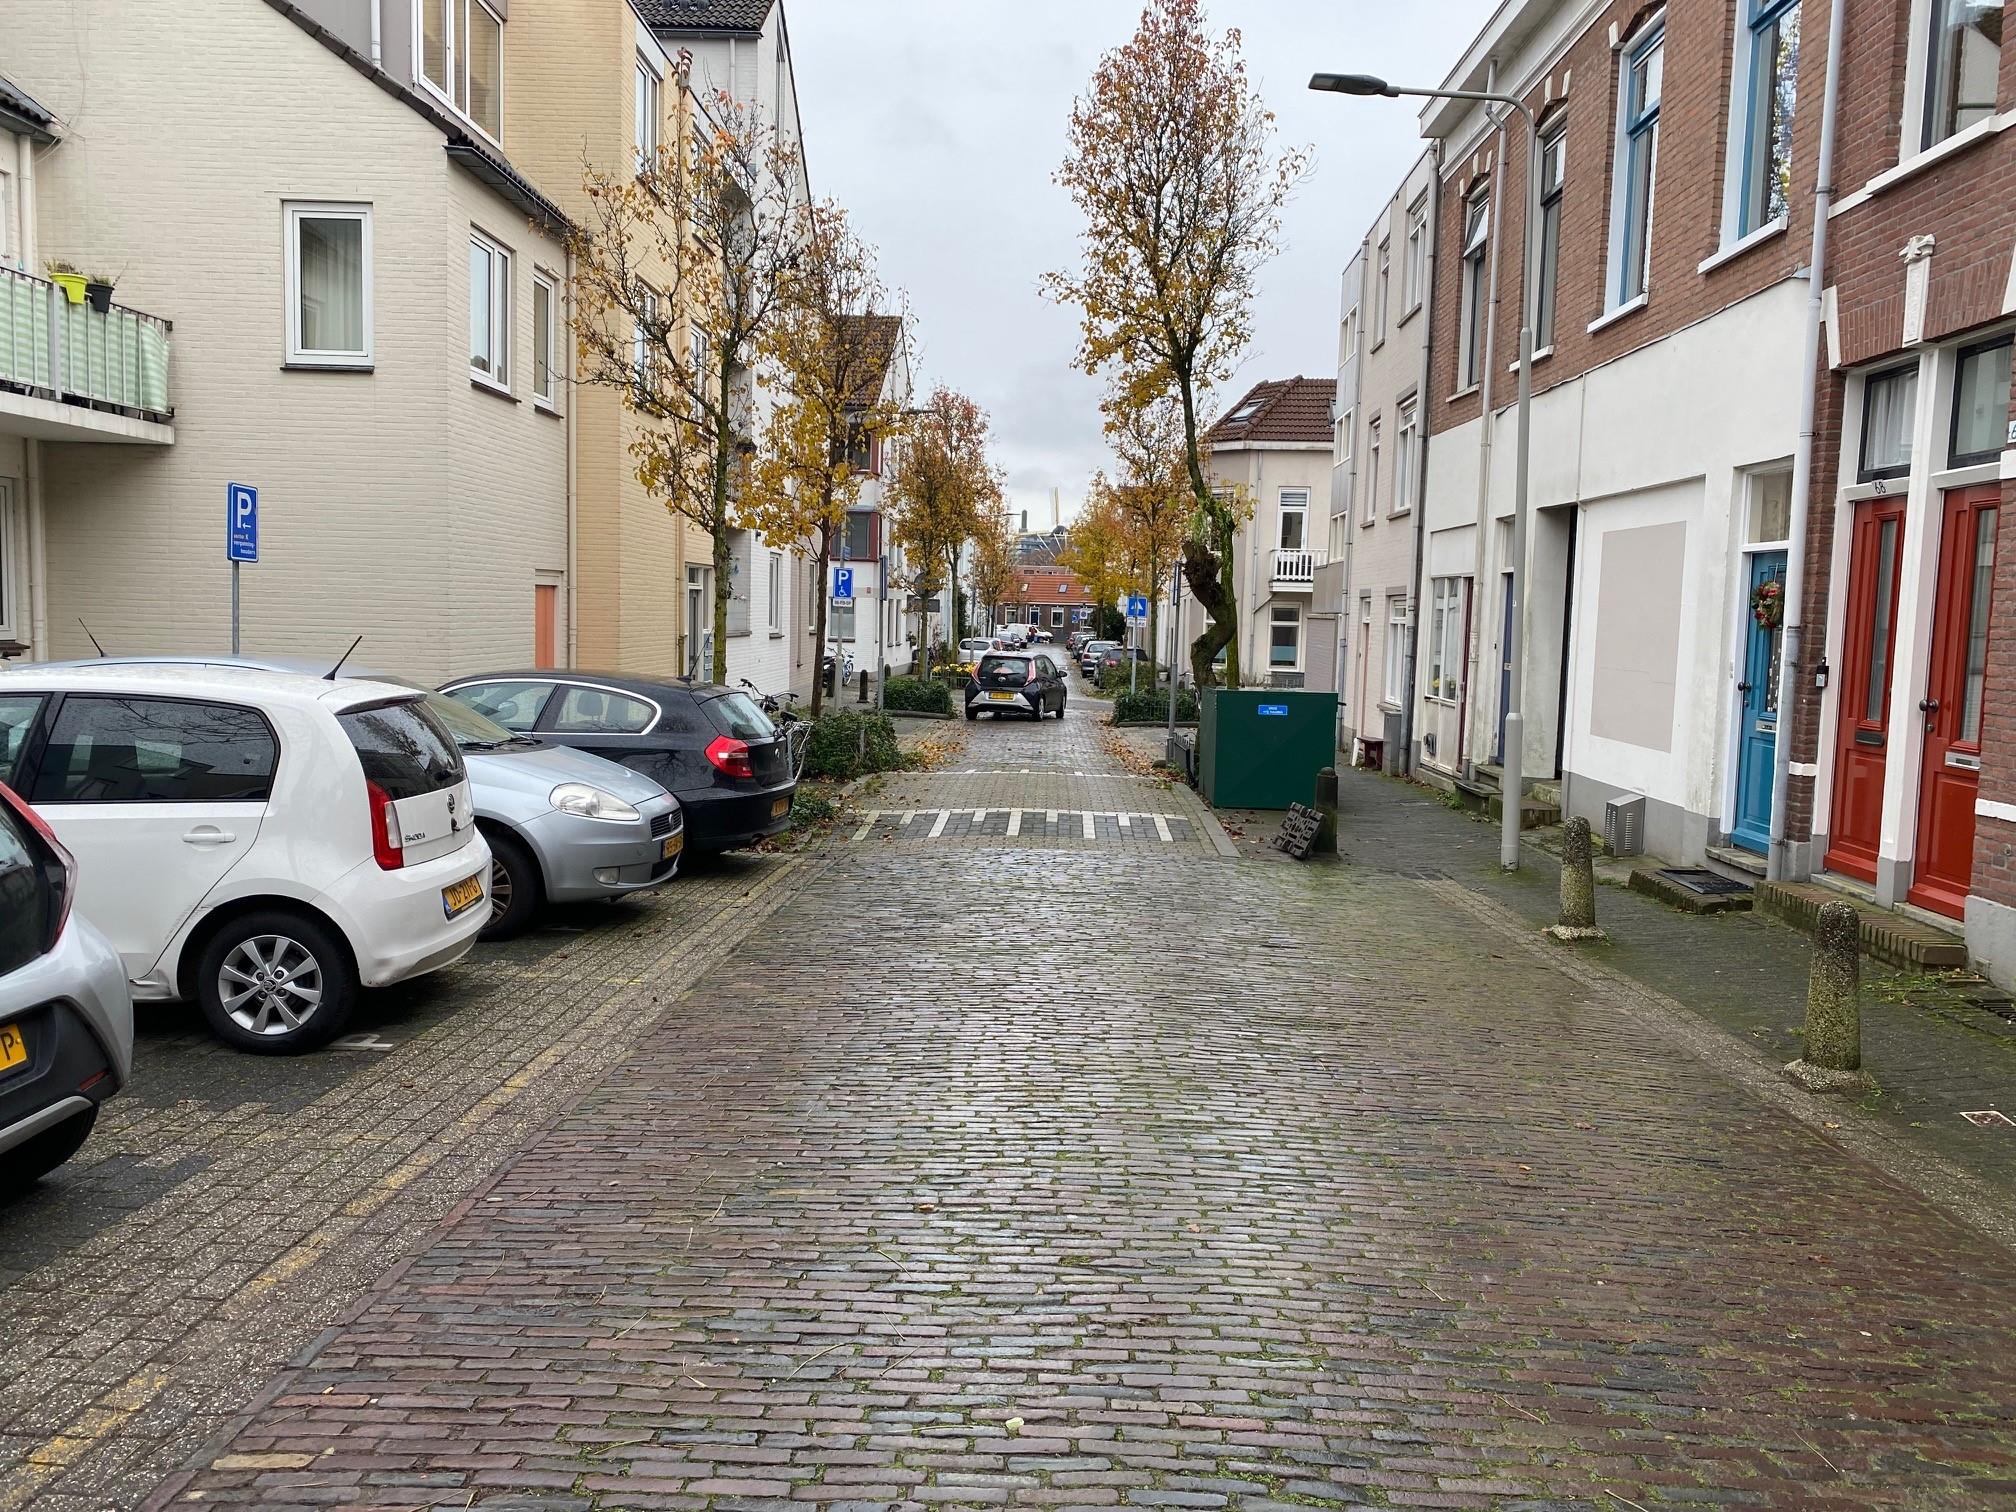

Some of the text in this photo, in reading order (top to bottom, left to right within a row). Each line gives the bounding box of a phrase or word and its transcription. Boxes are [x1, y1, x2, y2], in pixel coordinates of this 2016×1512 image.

[1874, 481, 1886, 494] 68
[237, 491, 252, 528] P
[838, 570, 849, 585] P
